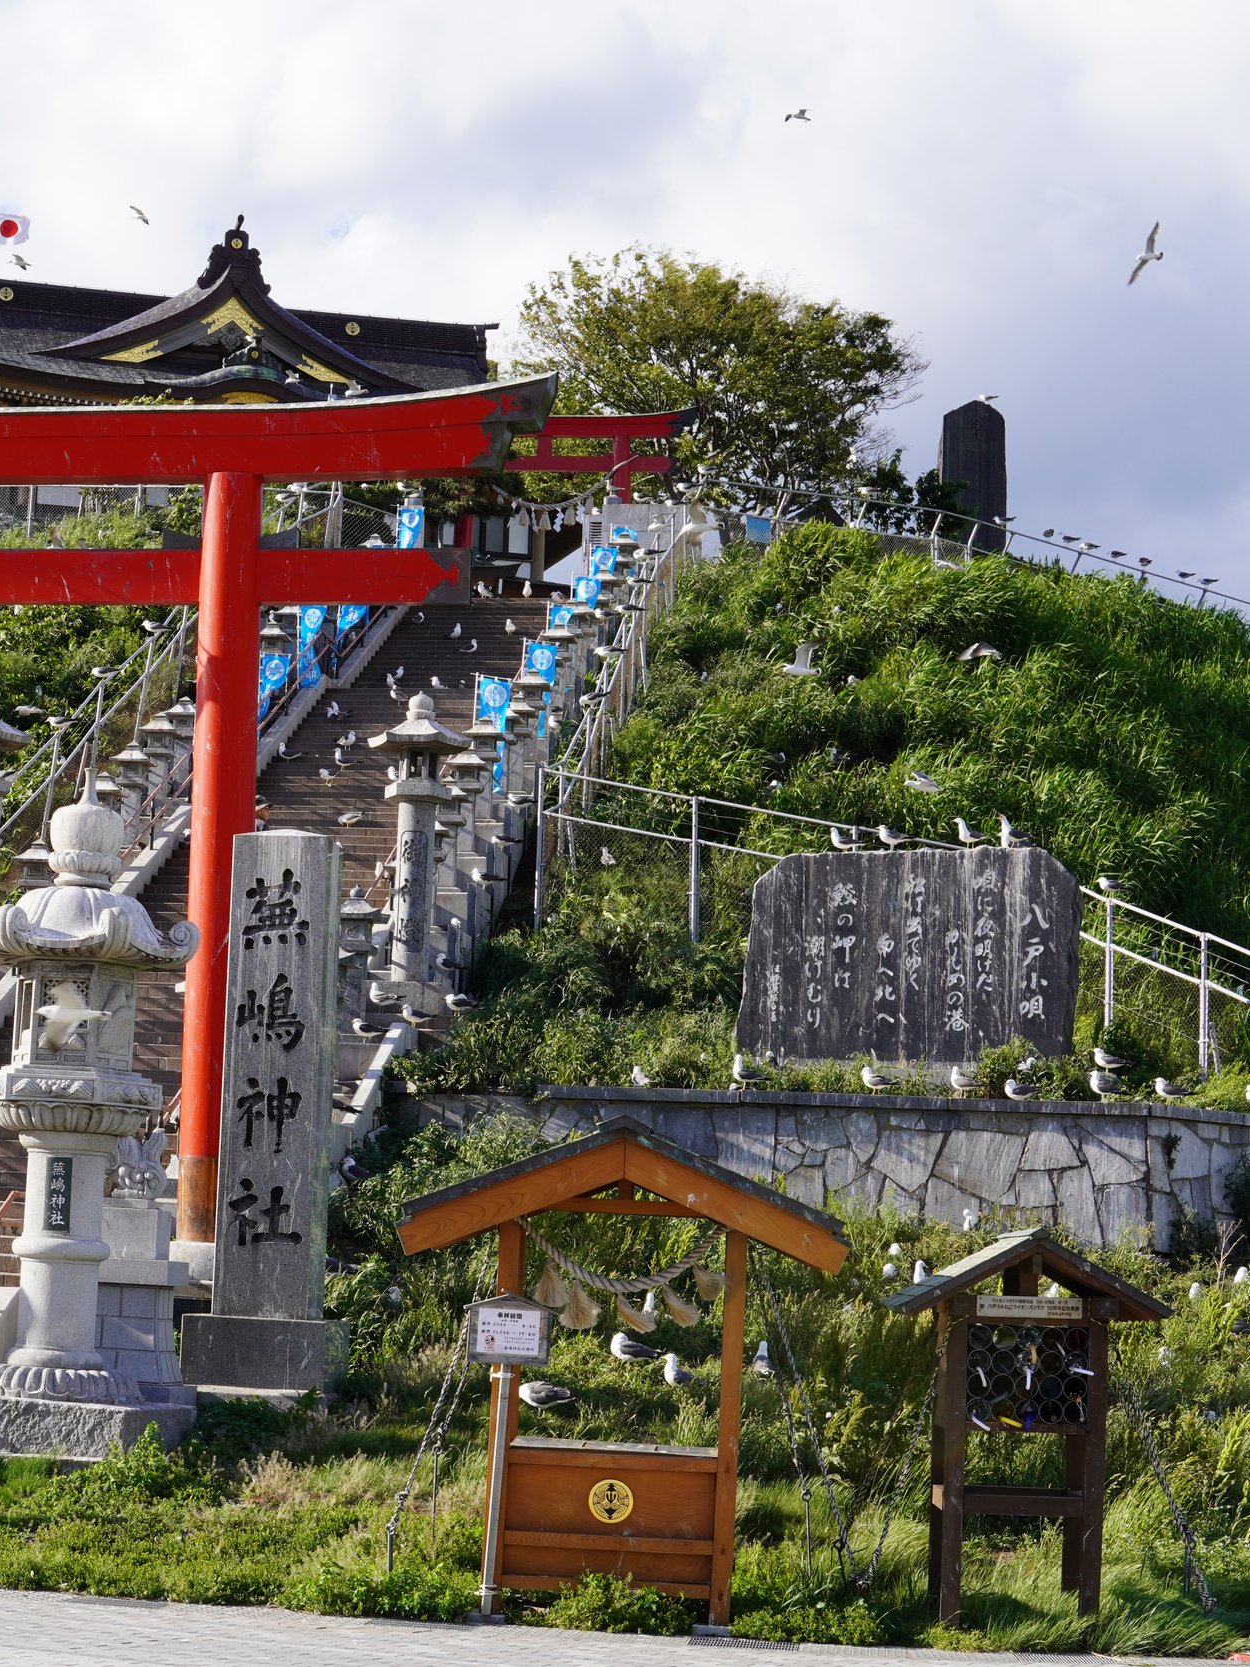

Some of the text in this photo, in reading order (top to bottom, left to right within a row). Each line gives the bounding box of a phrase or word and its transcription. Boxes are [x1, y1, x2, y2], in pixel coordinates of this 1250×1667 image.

[804, 935, 826, 1029] 潮けむり
[831, 882, 858, 989] 鮫の岬は
[873, 932, 896, 1024] 南へ北へ
[973, 869, 998, 992] 唄に夜明けた
[1019, 902, 1050, 1020] 八戸小唄
[228, 868, 310, 1247] 蕪嶋神社
[48, 1161, 66, 1226] 蕪嶋神社
